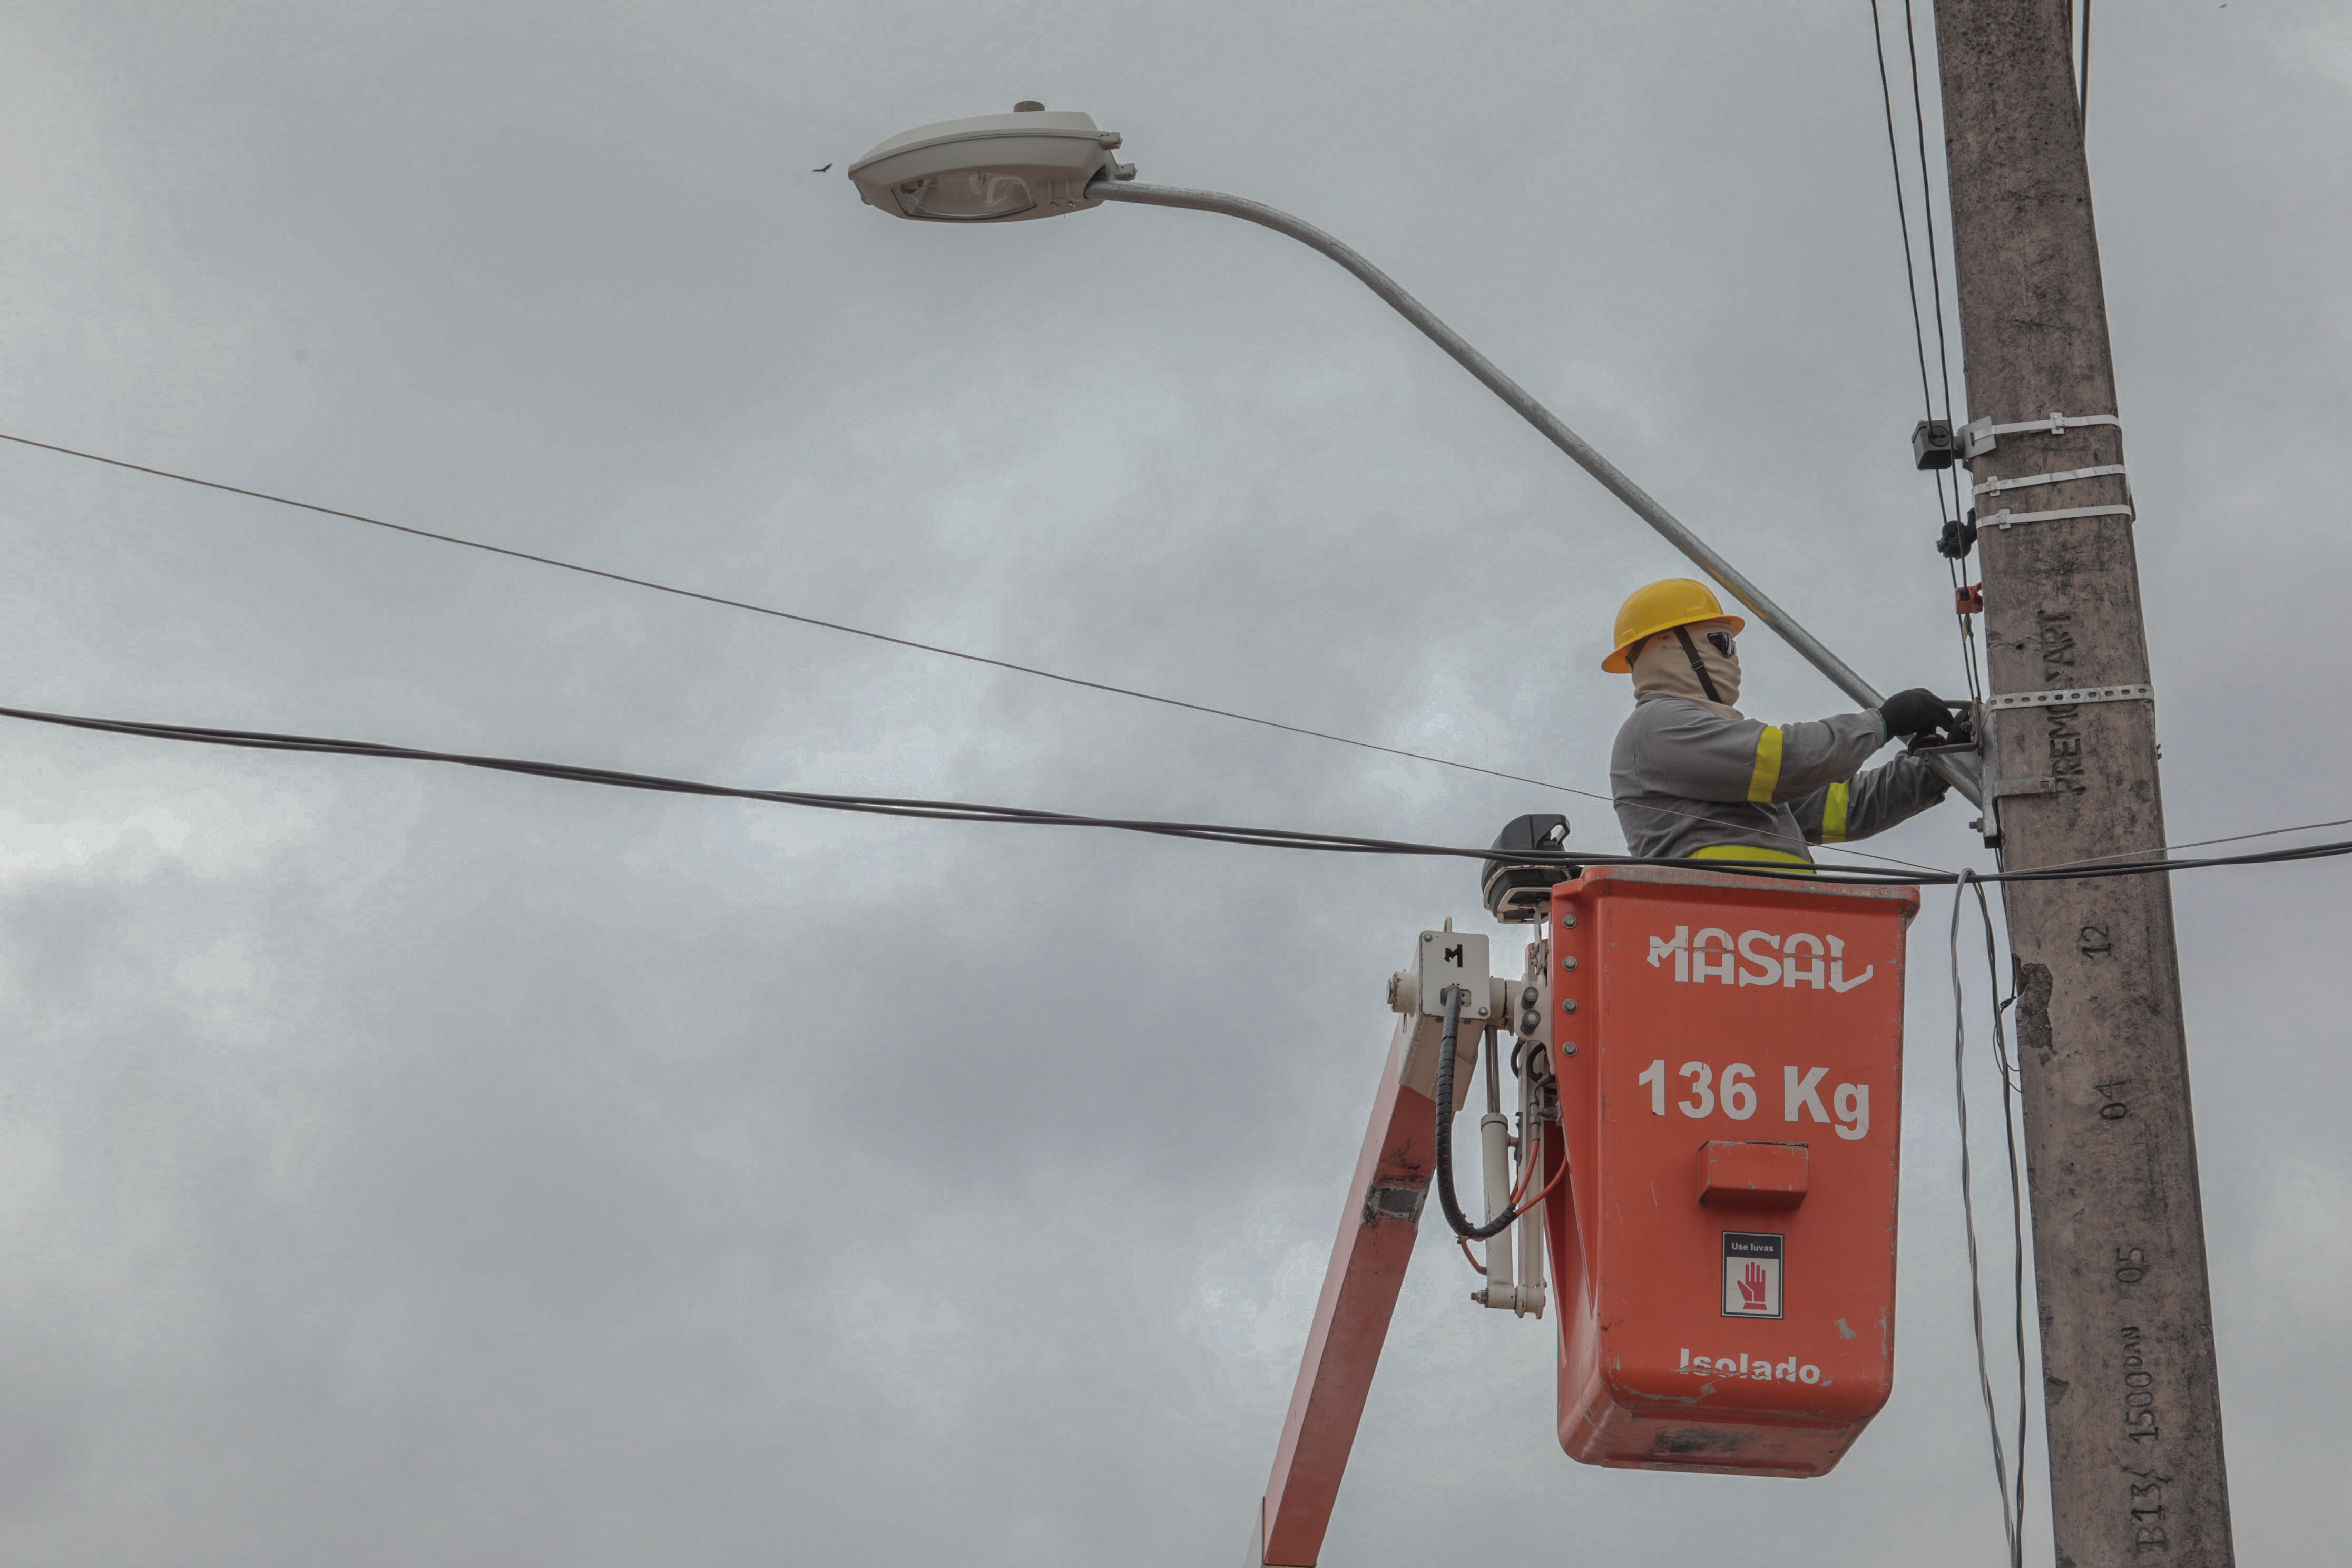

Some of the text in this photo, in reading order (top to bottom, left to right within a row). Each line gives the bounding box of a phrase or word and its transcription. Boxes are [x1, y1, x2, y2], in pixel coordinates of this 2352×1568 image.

[1647, 925, 1874, 993] MASAL
[2080, 926, 2111, 961] 12
[1639, 1059, 1869, 1140] 136 Kg
[2093, 1076, 2128, 1121] 04
[1751, 1243, 1774, 1252] luvas
[2115, 1247, 2145, 1283] 05
[1679, 1348, 1821, 1384] Isolado
